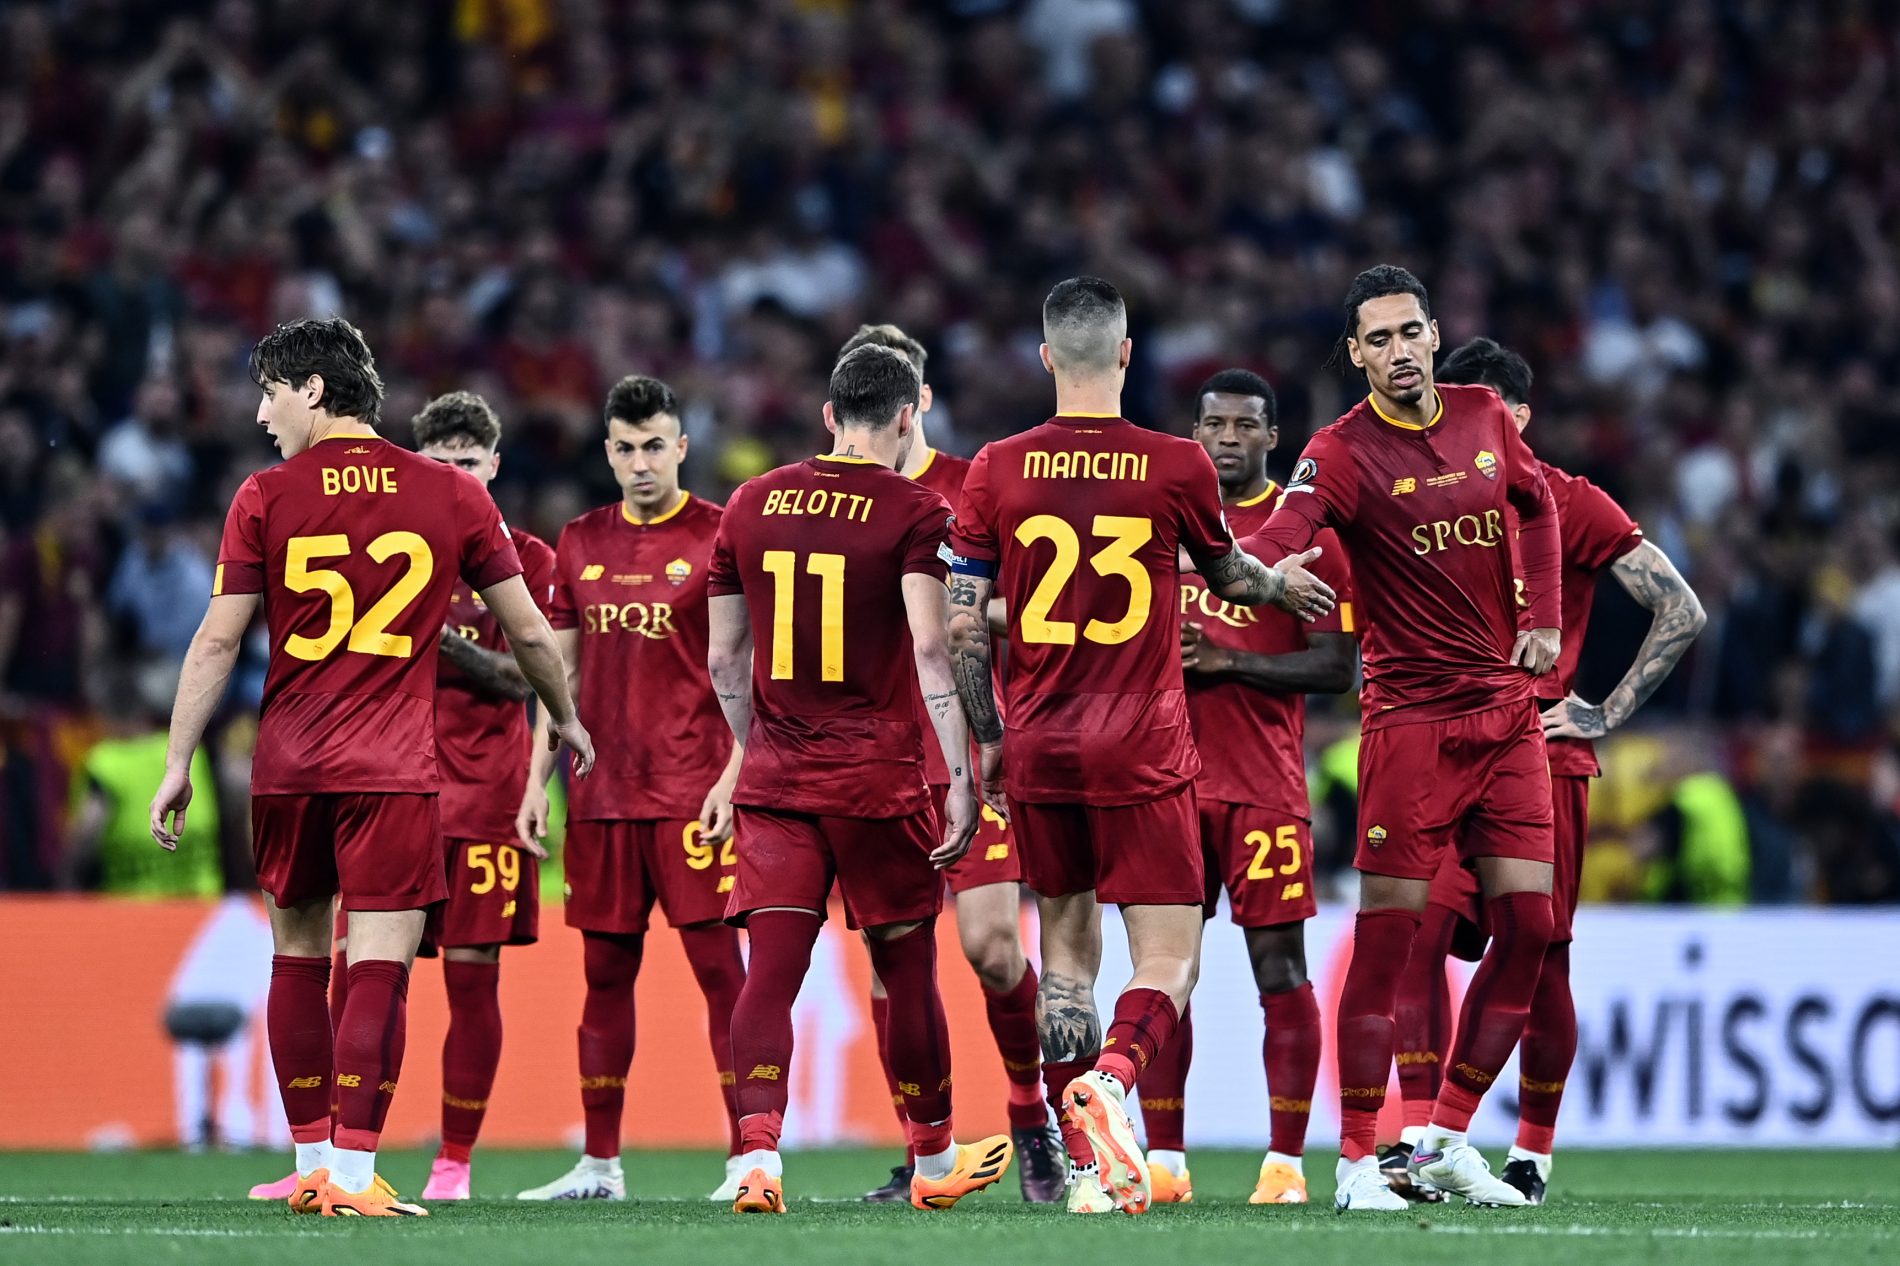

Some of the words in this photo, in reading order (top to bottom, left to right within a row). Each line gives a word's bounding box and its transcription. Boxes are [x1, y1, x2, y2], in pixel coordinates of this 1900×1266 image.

[321, 465, 397, 495] BOVE
[1023, 451, 1149, 481] MANCINI
[762, 489, 873, 522] BELOTTI
[1411, 509, 1503, 555] SPQR
[284, 531, 433, 661] 52
[1014, 514, 1152, 645] 23
[584, 602, 678, 640] SPQR
[762, 550, 845, 682] 11
[1180, 585, 1259, 627] PQR
[467, 844, 520, 895] 59
[1243, 825, 1302, 880] 25
[1498, 942, 1900, 1124] wisso
